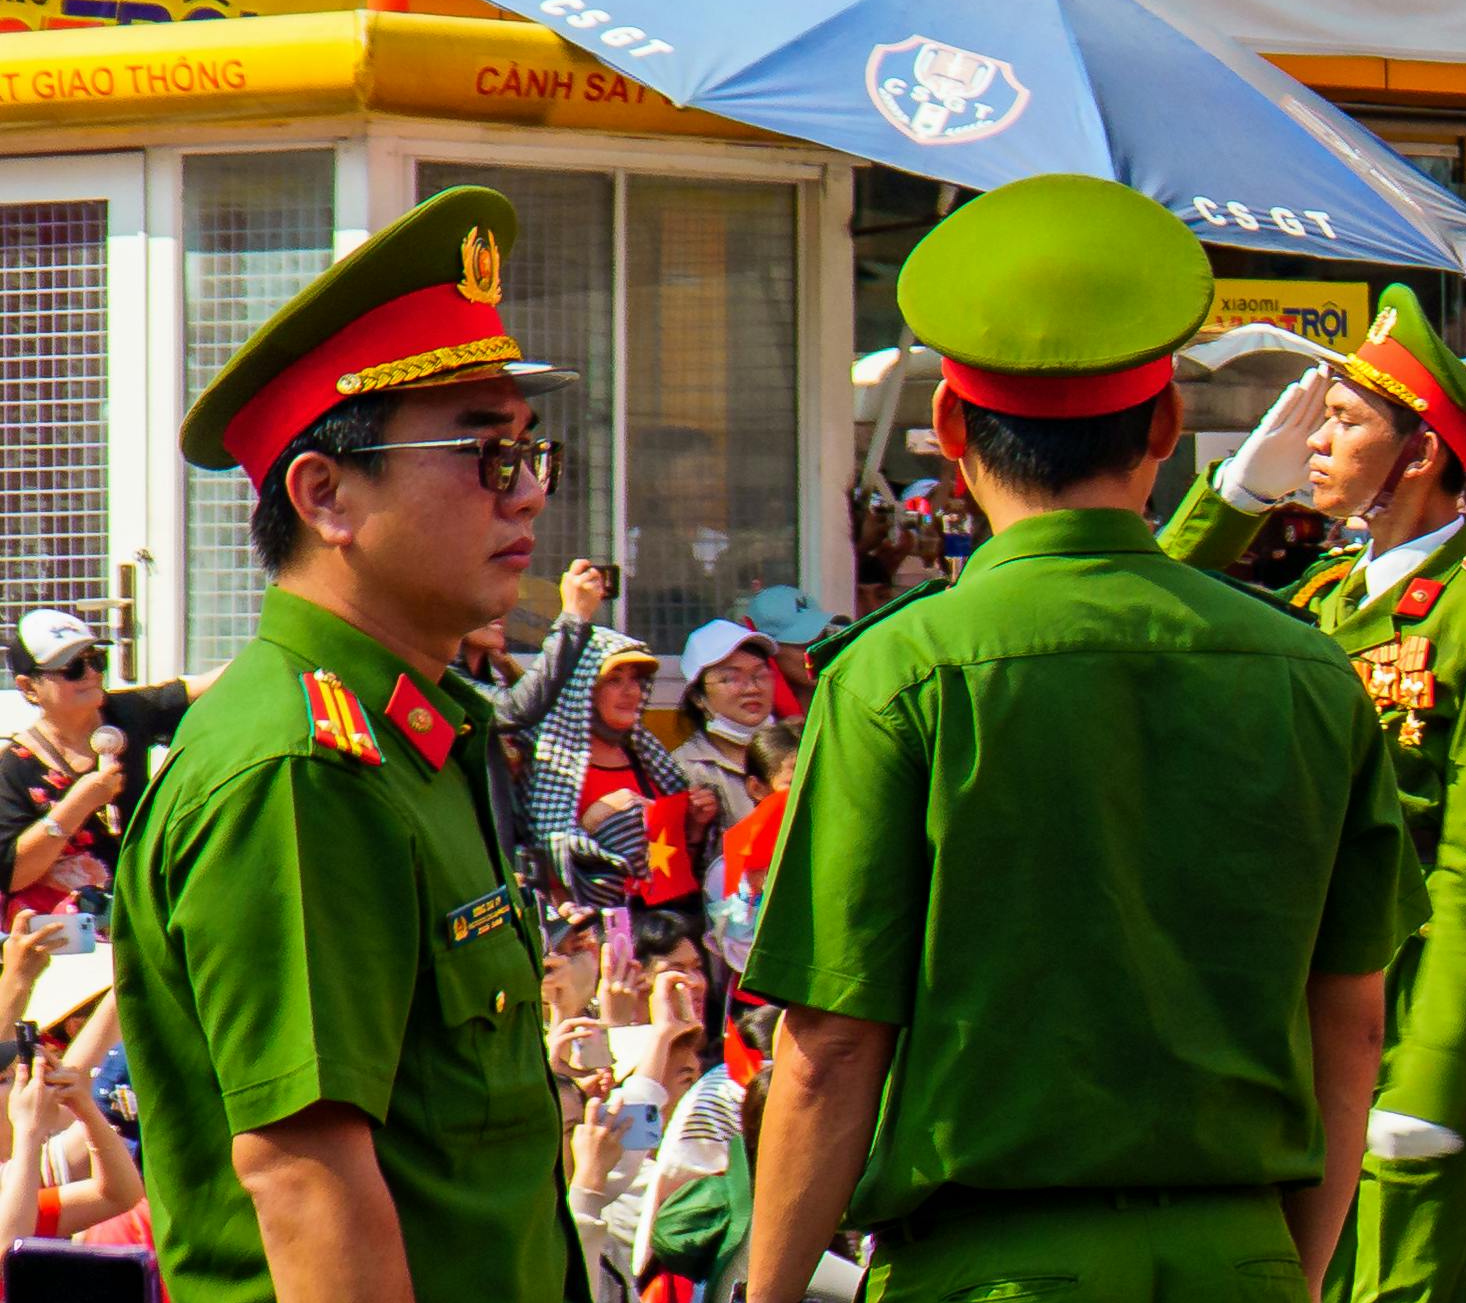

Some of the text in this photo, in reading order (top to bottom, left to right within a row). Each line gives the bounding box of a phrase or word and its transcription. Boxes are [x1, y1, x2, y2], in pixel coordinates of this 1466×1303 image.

[32, 66, 115, 99] GIAO
[126, 55, 246, 93] THÔNG
[475, 60, 574, 100] CẢNH
[1192, 194, 1338, 240] CSGT
